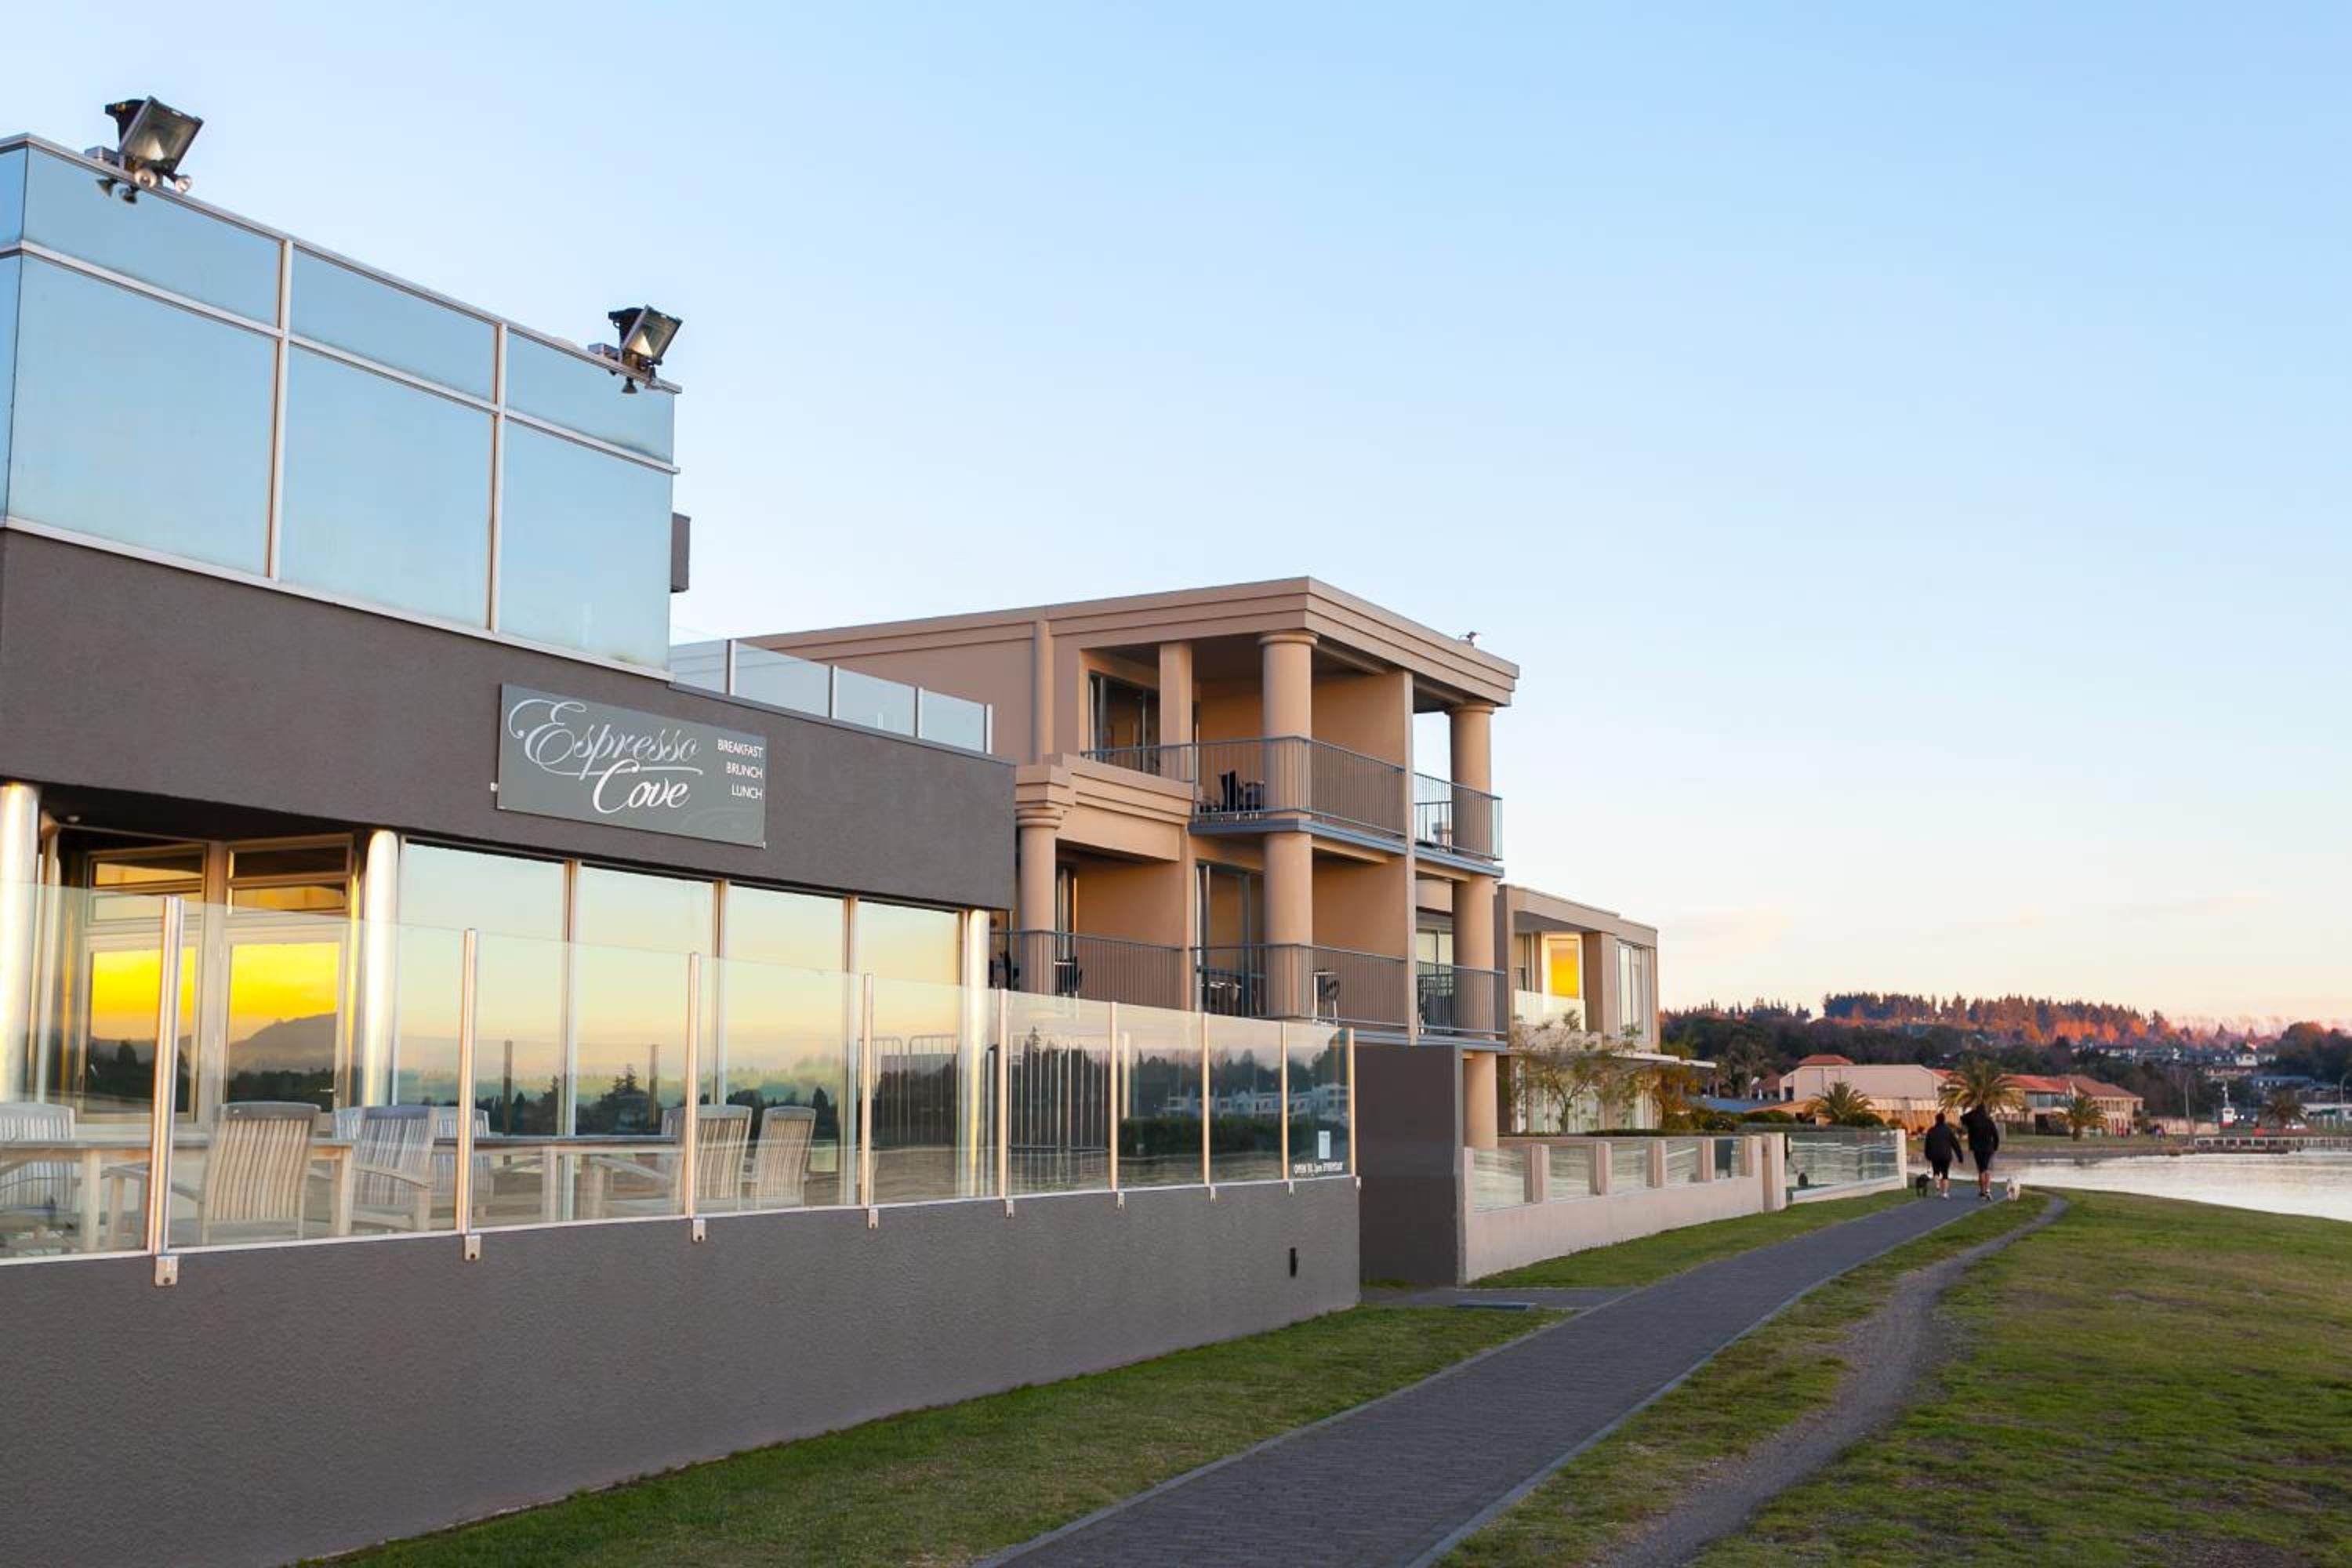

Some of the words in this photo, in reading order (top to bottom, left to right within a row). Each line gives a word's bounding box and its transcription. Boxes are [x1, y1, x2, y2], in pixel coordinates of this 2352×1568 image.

[509, 699, 702, 780] Espresso
[717, 739, 764, 759] BREAKFAST
[726, 761, 763, 779] BRUNCH
[592, 758, 691, 814] Cove
[731, 783, 763, 800] LUNCH
